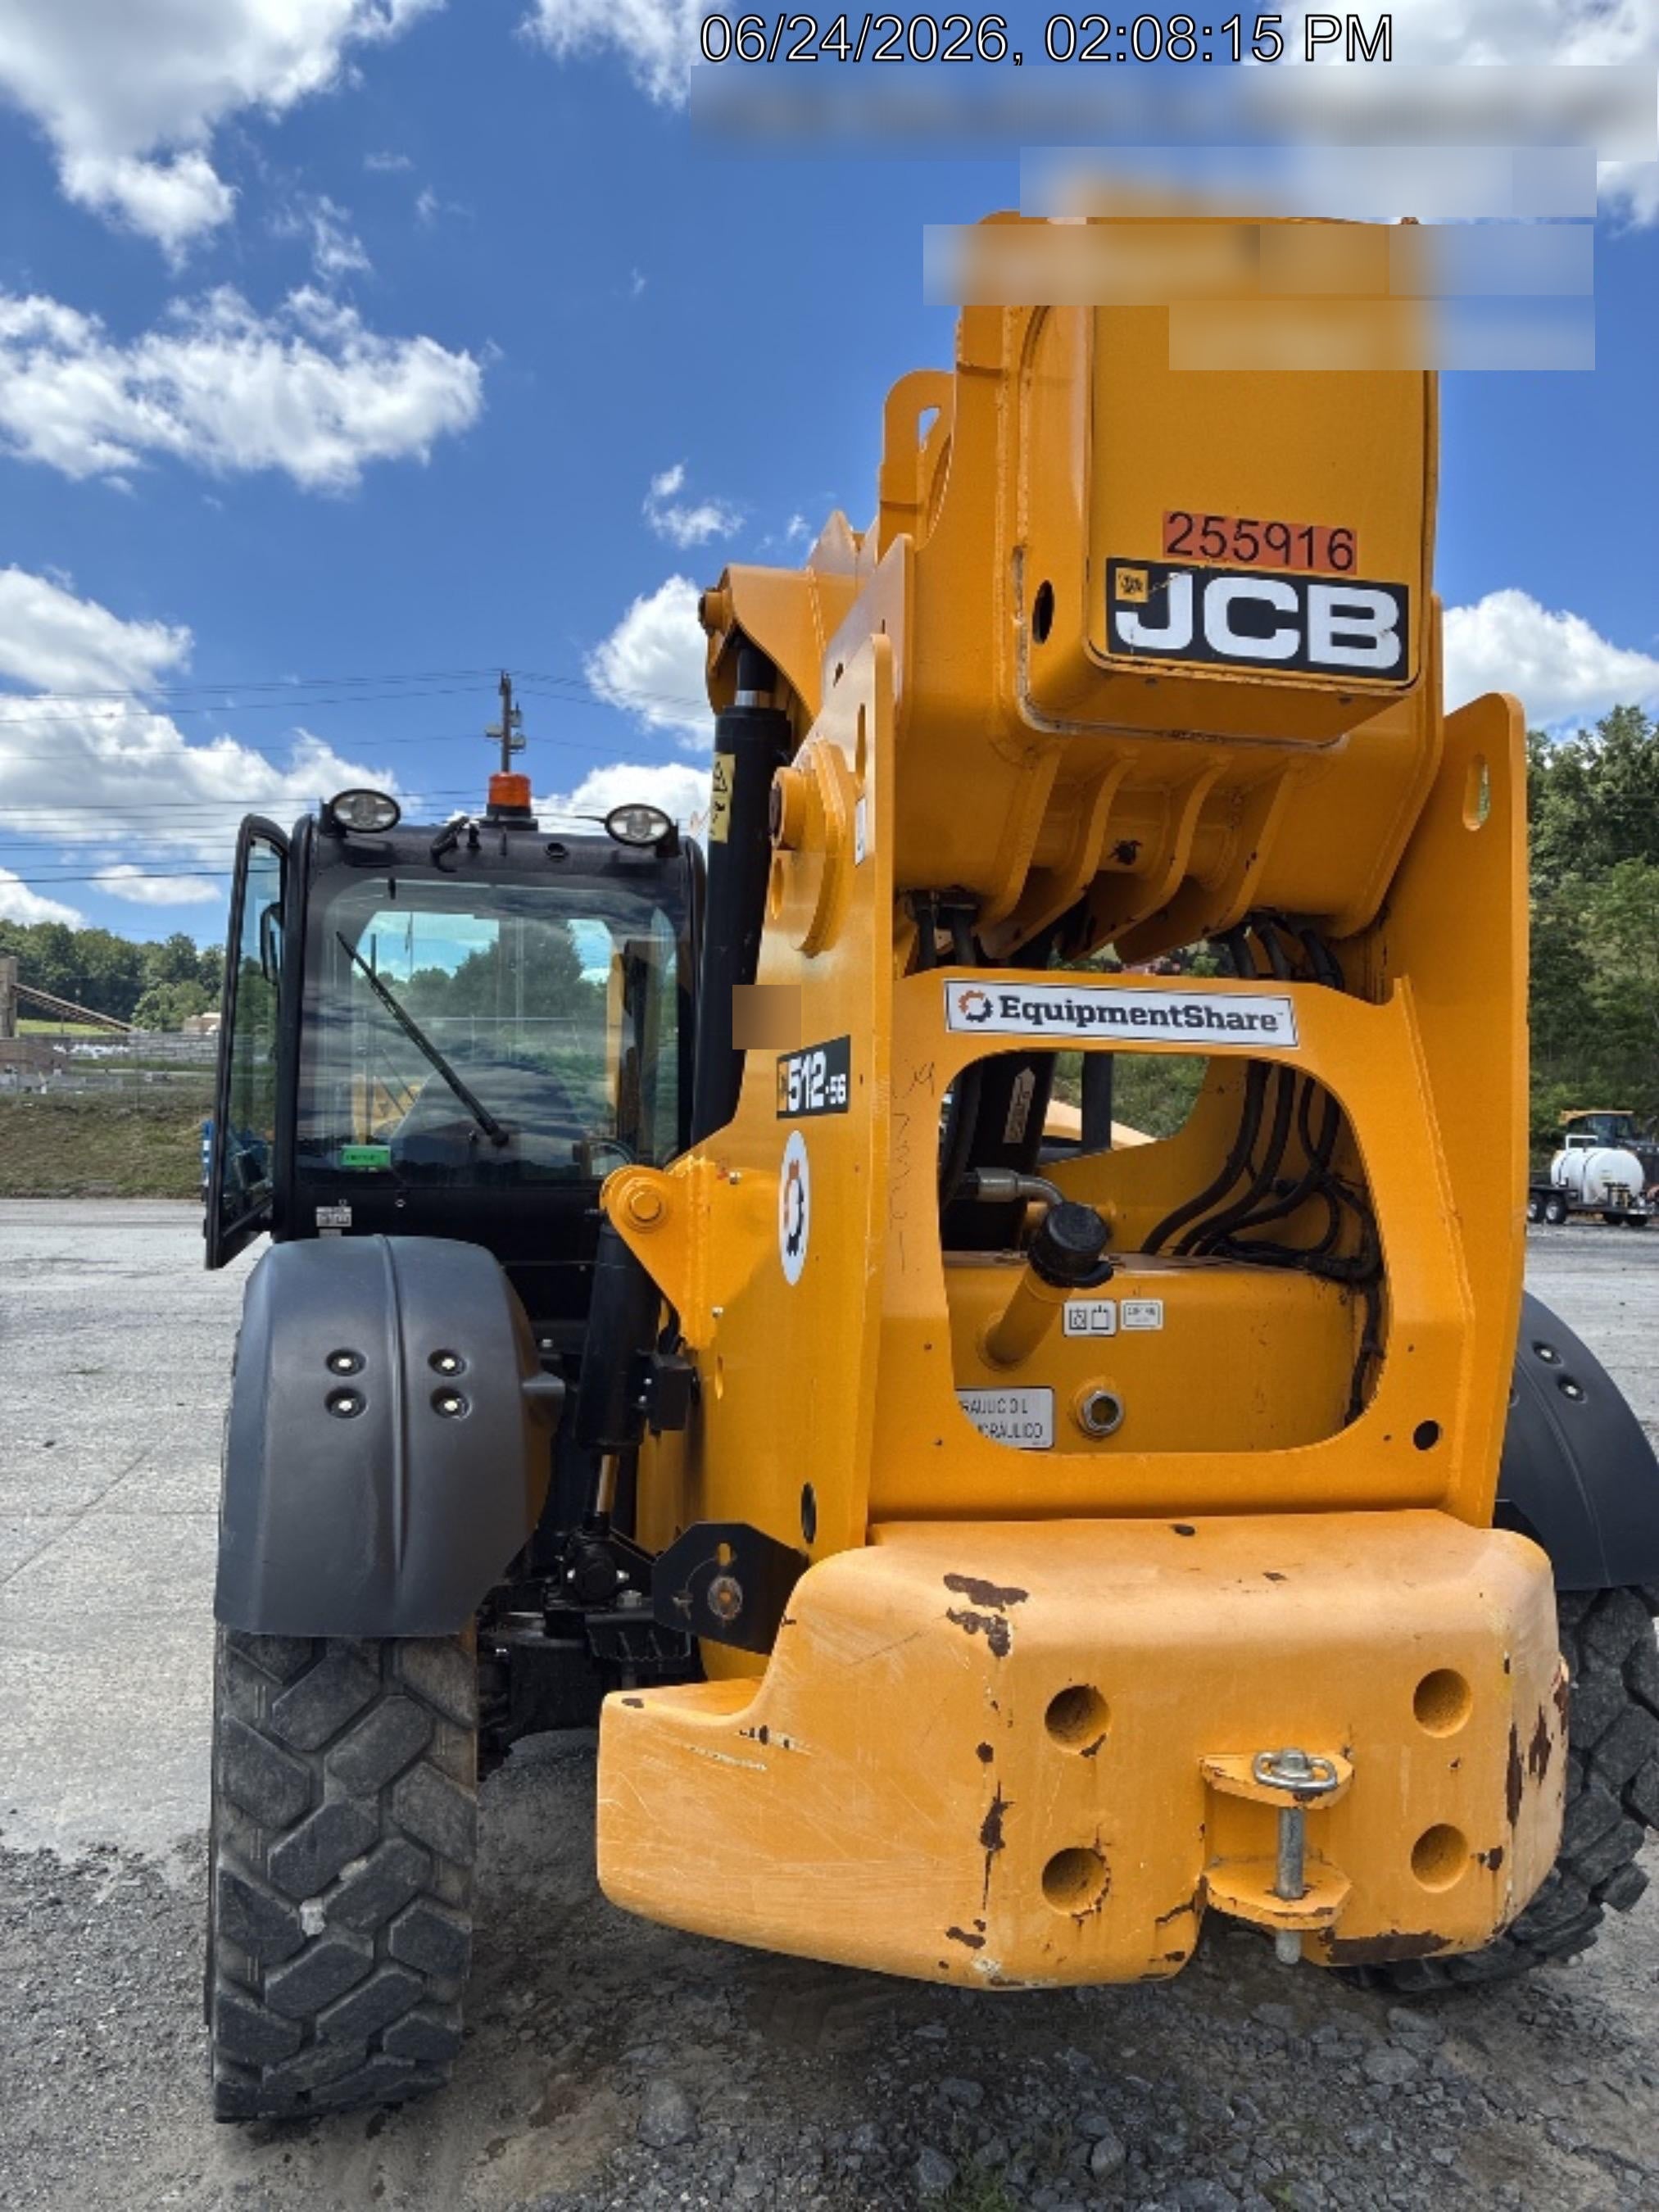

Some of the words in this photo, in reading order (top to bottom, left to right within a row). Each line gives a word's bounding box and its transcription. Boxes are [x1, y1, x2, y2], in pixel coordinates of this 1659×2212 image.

[1167, 510, 1354, 572] 255916
[1115, 572, 1403, 670] JCB
[998, 995, 1279, 1033] EquipmentShare
[1009, 1398, 1028, 1414] OL
